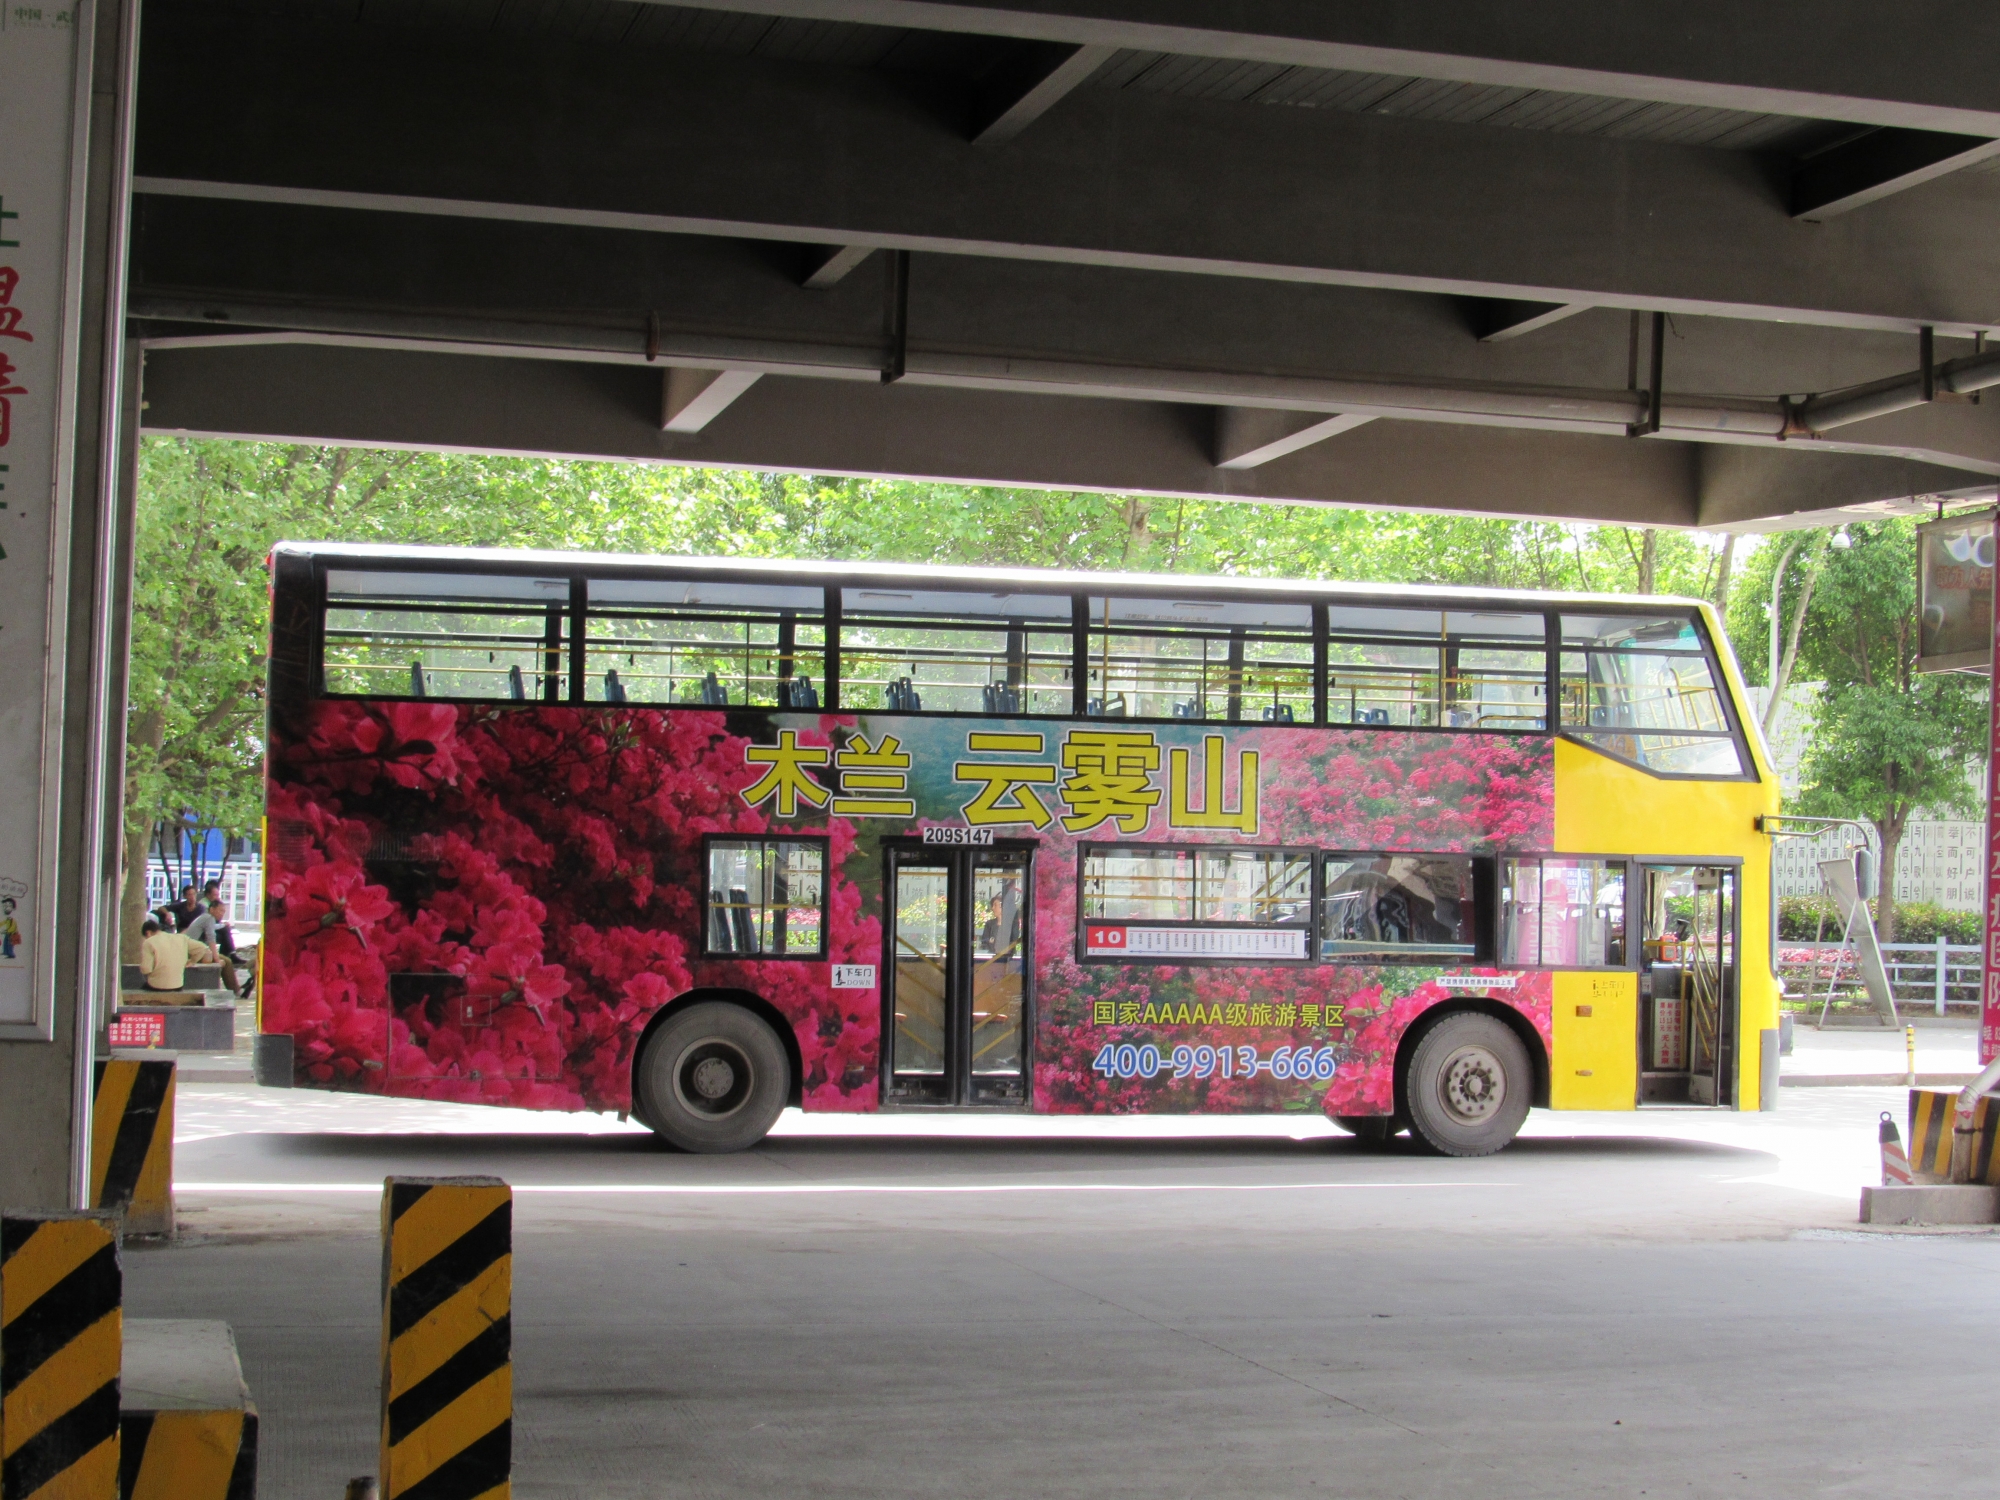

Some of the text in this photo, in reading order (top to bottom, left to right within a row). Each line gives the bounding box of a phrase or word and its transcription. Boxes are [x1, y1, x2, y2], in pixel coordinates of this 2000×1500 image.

[741, 729, 1260, 838] 木兰 云雾山
[925, 829, 993, 845] 209S147
[1095, 930, 1122, 944] 10
[846, 967, 872, 977] 下车门
[1093, 1001, 1346, 1028] 国家AAAAA级旅游景区
[1093, 1043, 1336, 1079] 400-9913-666
